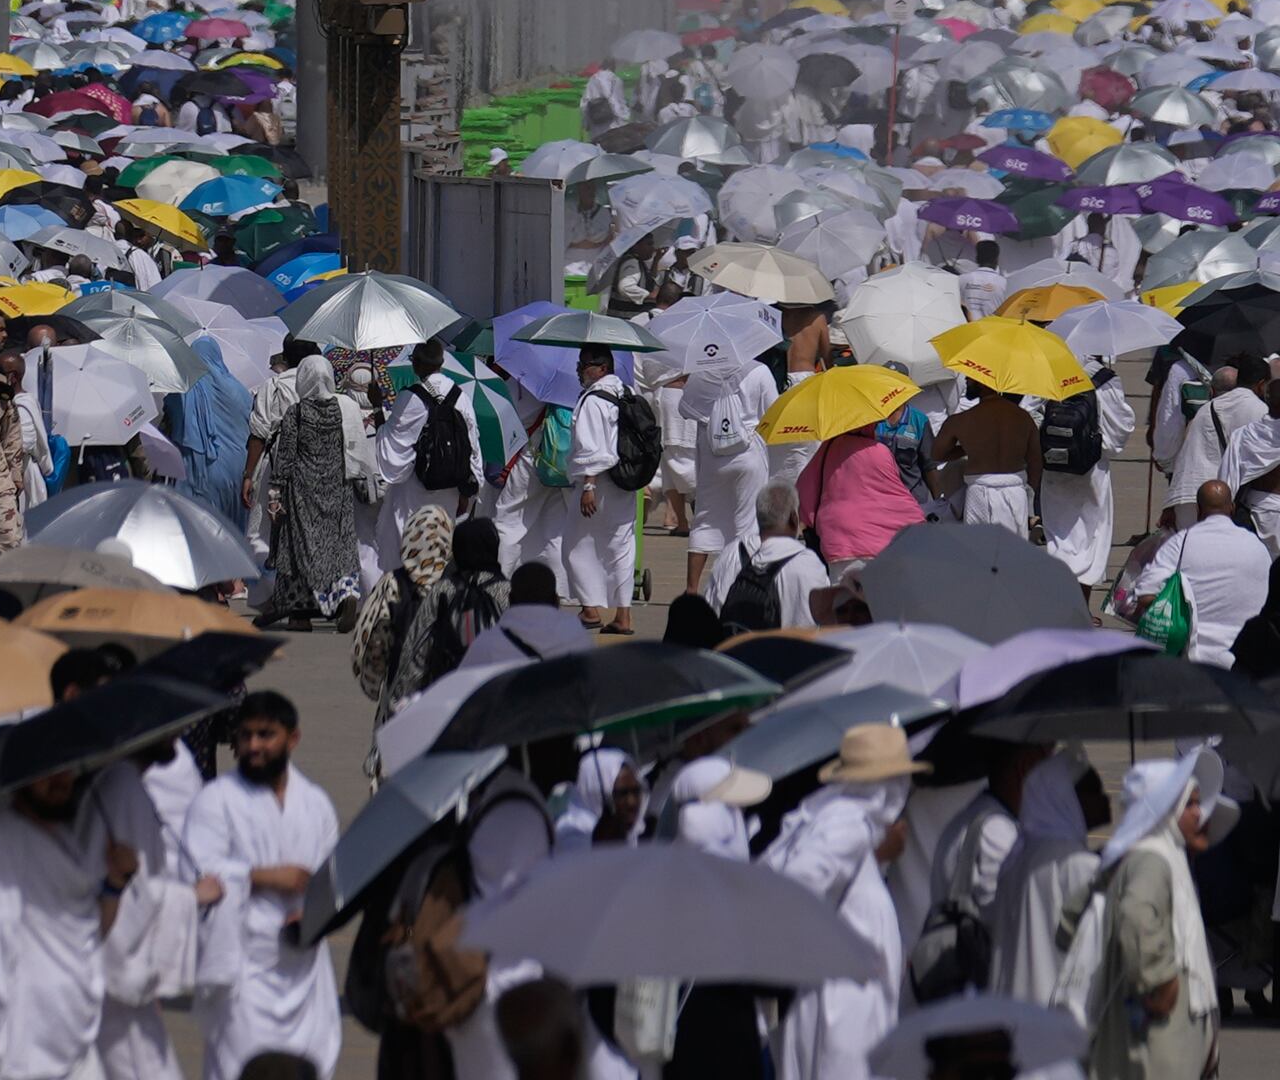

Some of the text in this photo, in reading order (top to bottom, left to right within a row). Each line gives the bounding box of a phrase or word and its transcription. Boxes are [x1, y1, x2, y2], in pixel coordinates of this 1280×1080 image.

[1187, 206, 1213, 220] stc
[956, 214, 982, 228] stc
[962, 360, 994, 378] DHL
[881, 388, 906, 406] DHL
[780, 426, 811, 434] DHL
